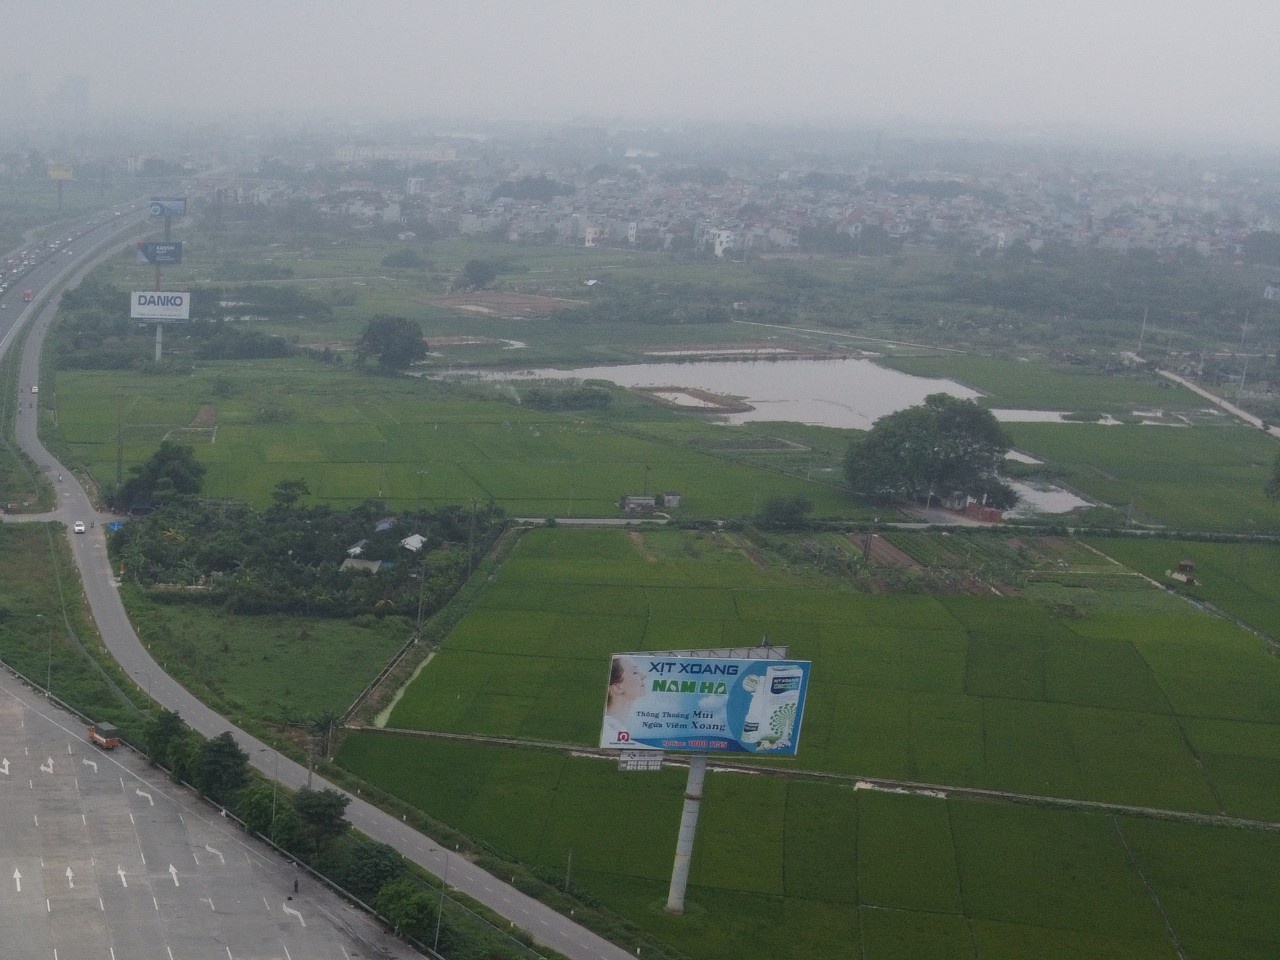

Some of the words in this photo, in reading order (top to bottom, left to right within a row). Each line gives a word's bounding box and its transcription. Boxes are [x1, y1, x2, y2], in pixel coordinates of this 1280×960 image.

[138, 295, 183, 307] DANKO
[649, 662, 676, 676] XỊT
[678, 663, 739, 675] XOANG
[652, 679, 696, 693] NAM
[699, 678, 728, 694] HÀ
[661, 711, 690, 719] Thoáng
[690, 721, 726, 731] Xoang
